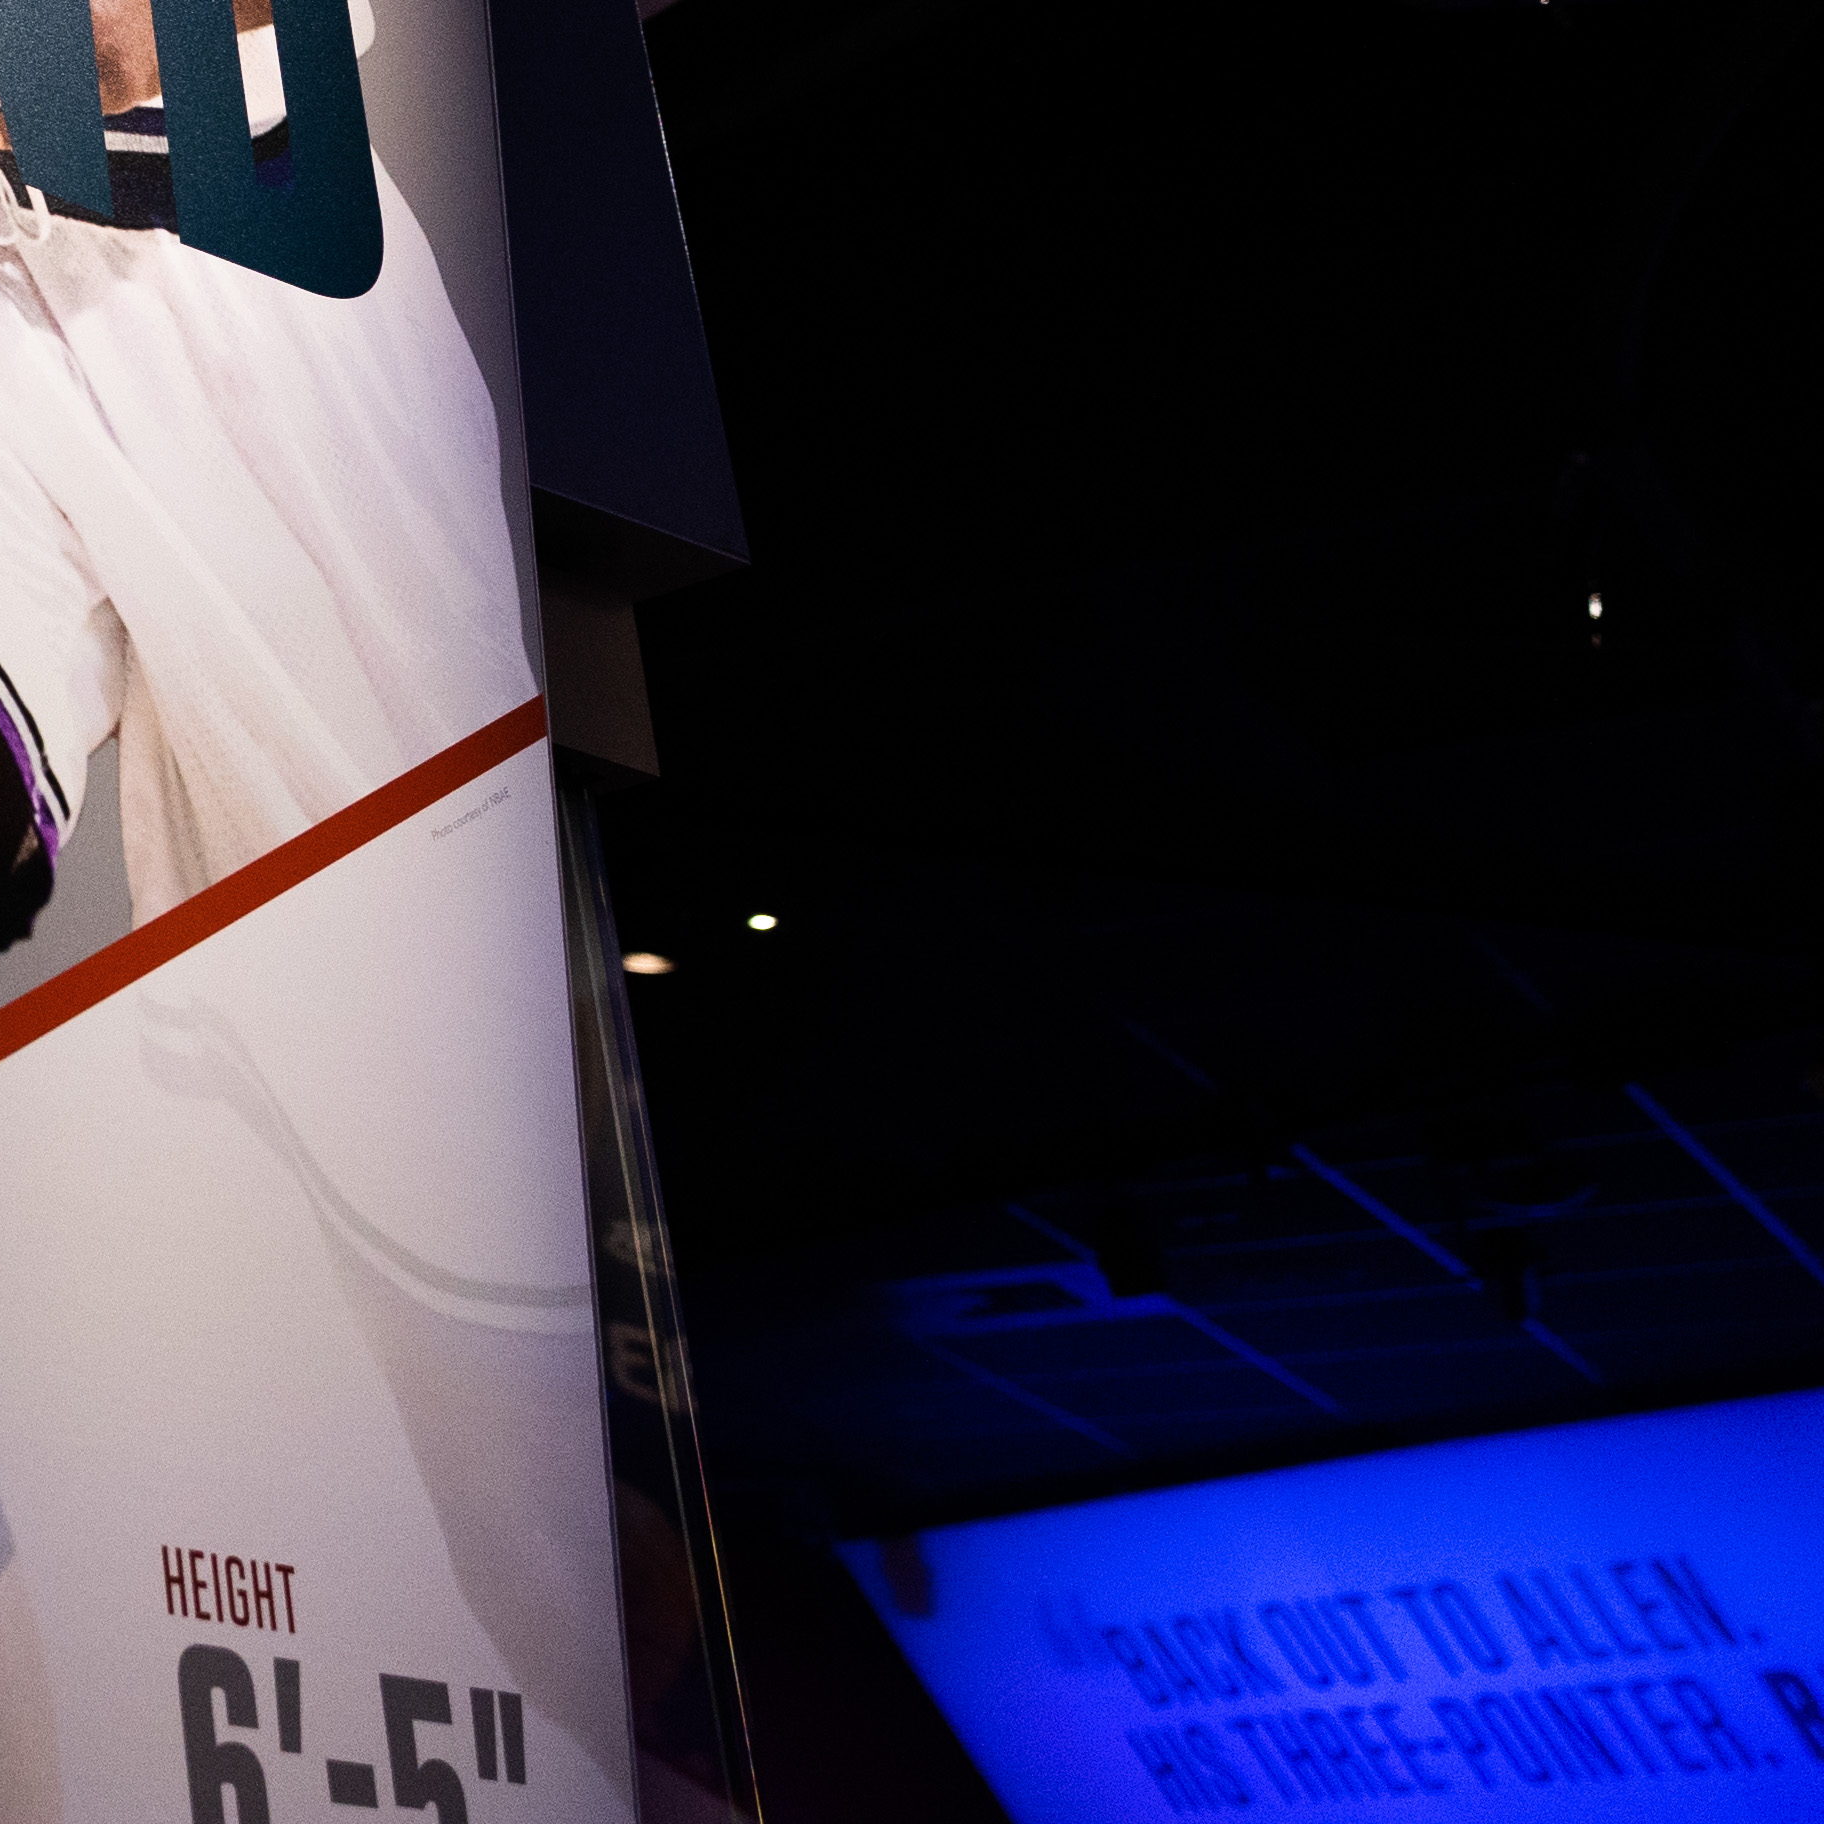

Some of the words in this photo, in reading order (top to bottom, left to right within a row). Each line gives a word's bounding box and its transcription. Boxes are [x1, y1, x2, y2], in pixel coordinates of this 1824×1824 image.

[160, 1544, 297, 1634] HEIGHT
[1259, 1592, 1407, 1690] OUT
[1386, 1579, 1510, 1674] TO
[1126, 1723, 1252, 1813] HIS
